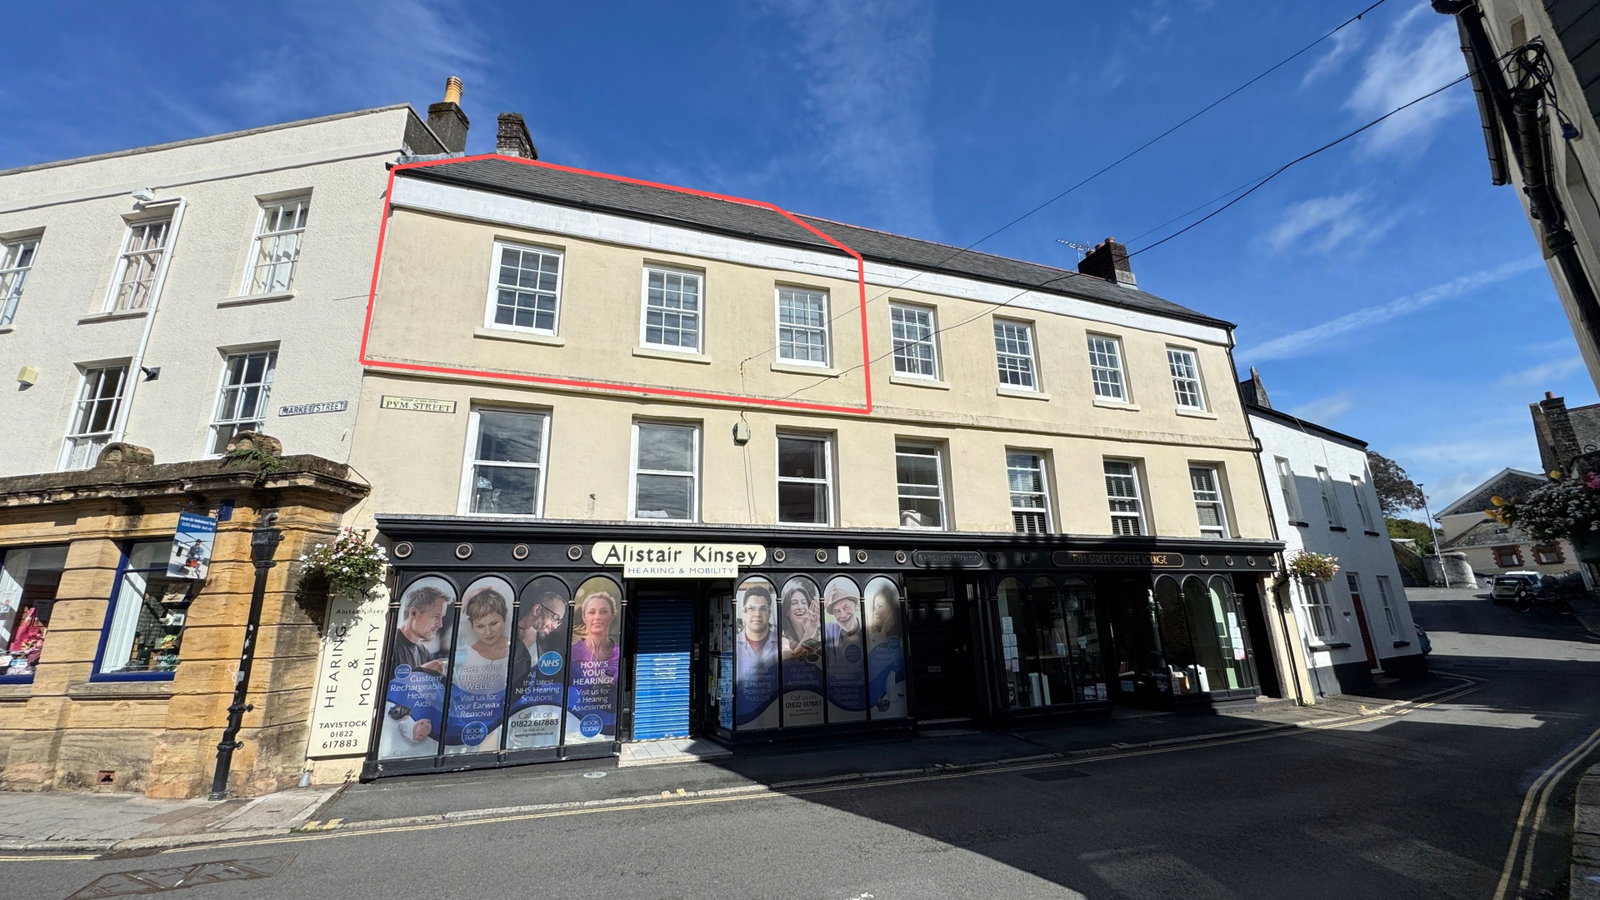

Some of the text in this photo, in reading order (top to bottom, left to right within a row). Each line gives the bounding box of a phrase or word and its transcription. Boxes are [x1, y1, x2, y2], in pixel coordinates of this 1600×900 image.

[280, 401, 345, 414] MARKET STREET
[386, 400, 408, 409] PYM
[412, 402, 451, 412] STREET
[602, 544, 758, 567] Alistair Kinsey
[1143, 554, 1169, 565] LOUNGE
[627, 567, 677, 575] HEARING
[689, 567, 736, 575] MOBILITY
[323, 626, 347, 709] HEARING
[347, 658, 360, 669] &
[358, 623, 381, 706] MOBILITY
[541, 659, 560, 667] NHS
[580, 661, 609, 669] HOW'S
[582, 669, 606, 677] YOUR
[410, 674, 443, 683] Custom
[572, 677, 615, 686] HEARING?
[390, 681, 445, 692] Rechargeable
[465, 682, 496, 690] WELL?
[515, 685, 560, 694] NHS Hearing
[407, 692, 437, 701] Hearing
[521, 694, 553, 702] Solutions
[582, 696, 609, 704] Hearing
[413, 700, 432, 708] Aids
[455, 701, 501, 711] your Earwax
[571, 703, 612, 711] Assessment
[460, 710, 494, 718] Removal
[319, 720, 368, 729] TAVISTOCK
[510, 719, 559, 728] 01822 617883
[330, 730, 354, 738] 01822
[322, 739, 358, 749] 617883
